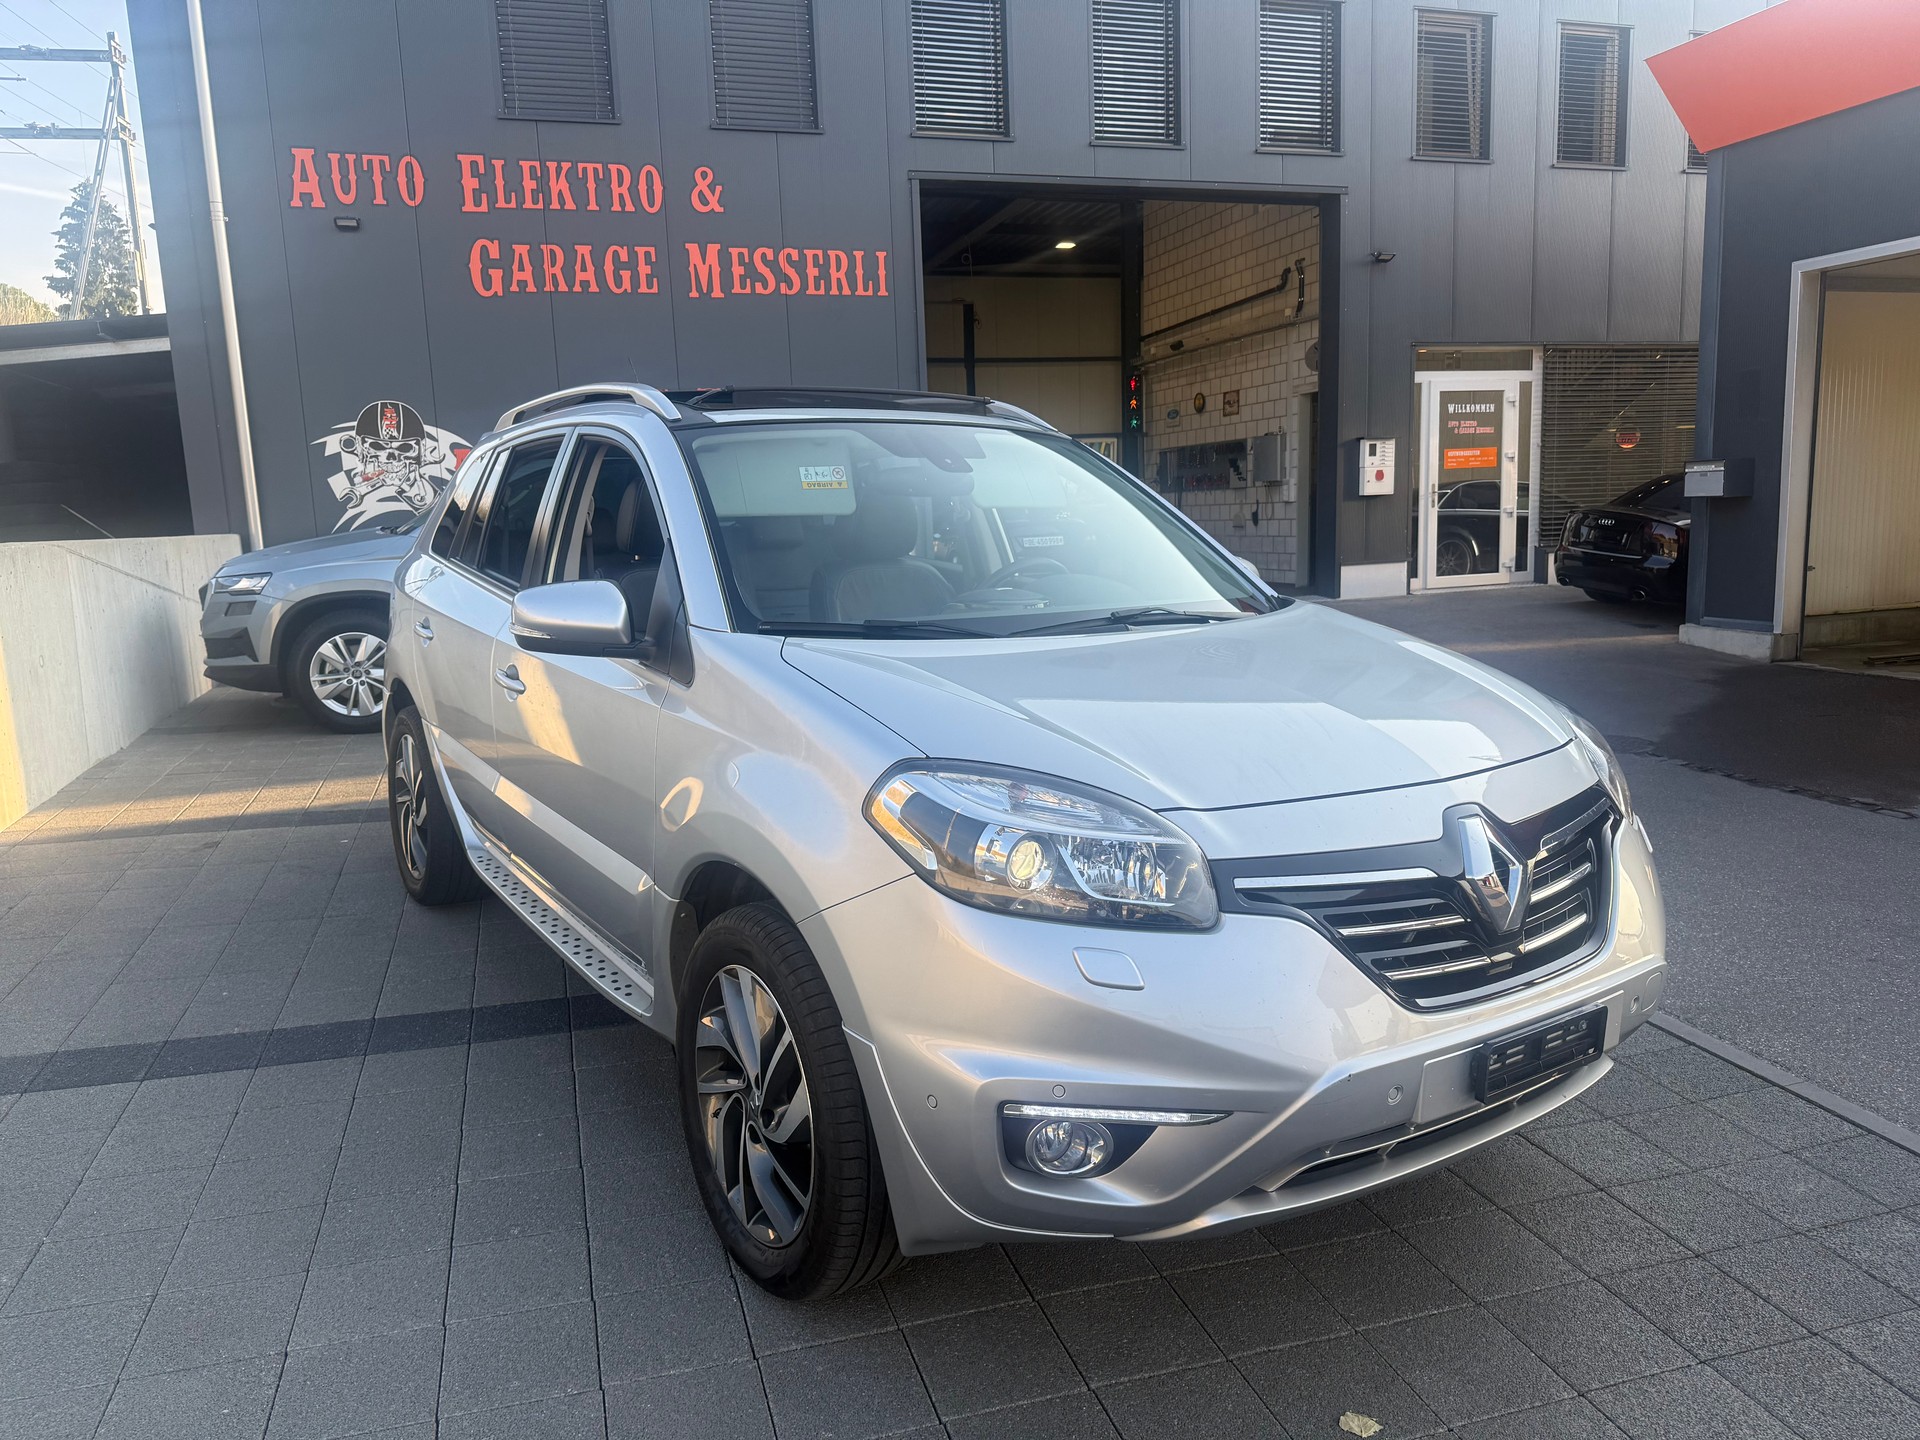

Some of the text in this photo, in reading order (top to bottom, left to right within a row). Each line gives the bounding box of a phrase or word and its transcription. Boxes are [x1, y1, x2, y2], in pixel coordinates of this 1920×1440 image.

[290, 148, 725, 215] AUTO ELEKTRO &
[469, 239, 889, 299] GARAGE MESSERLI
[1447, 404, 1495, 414] WILLKOMMEN
